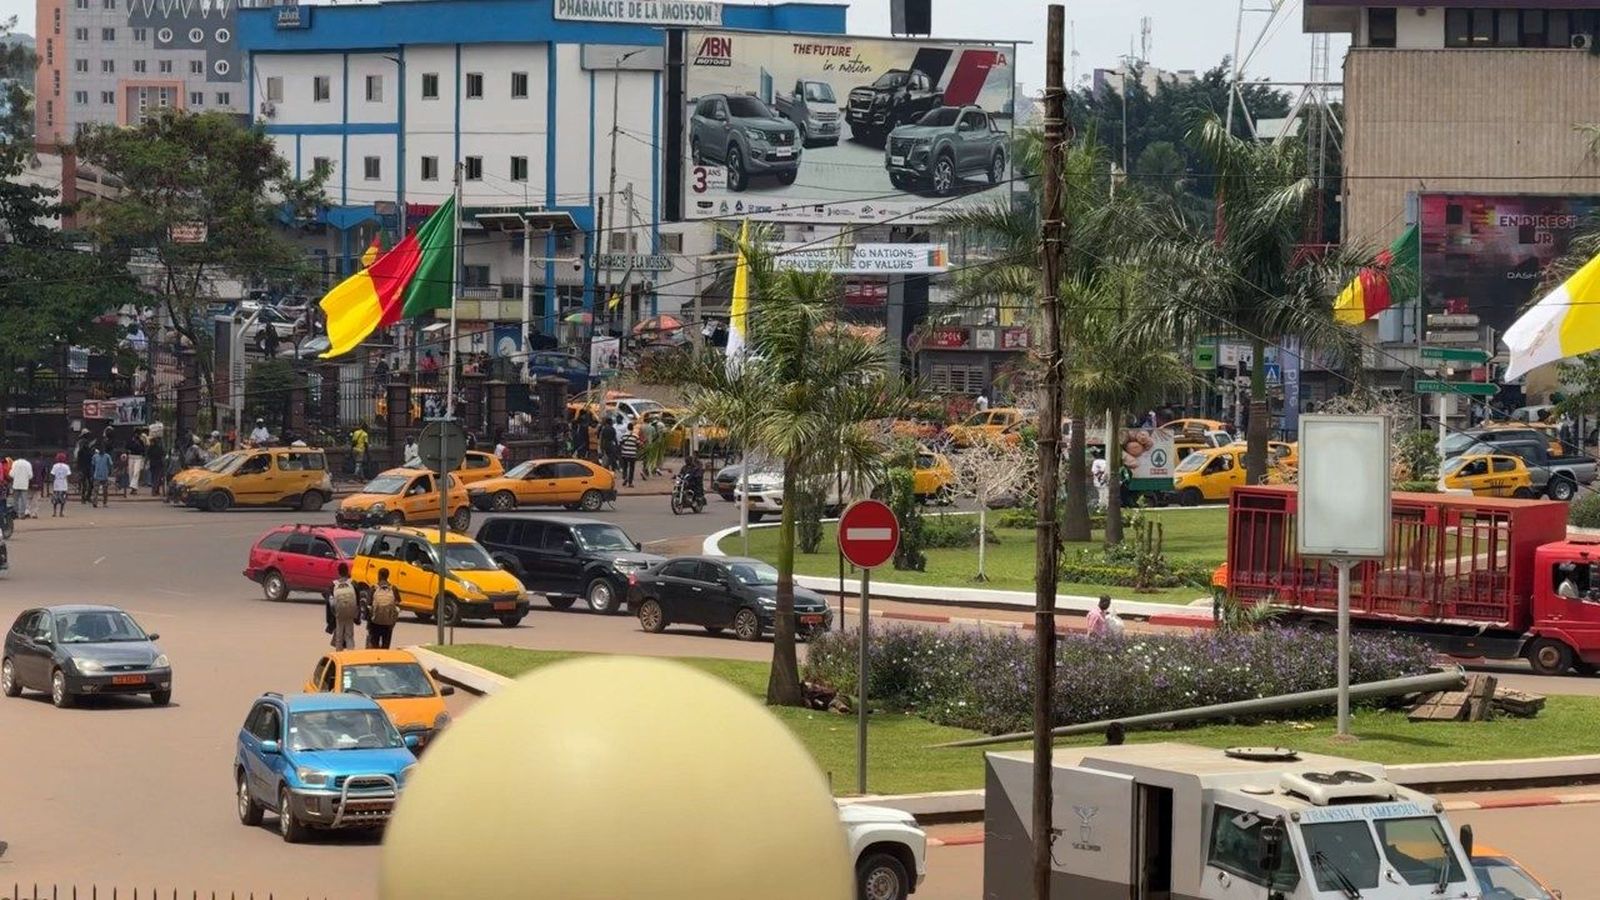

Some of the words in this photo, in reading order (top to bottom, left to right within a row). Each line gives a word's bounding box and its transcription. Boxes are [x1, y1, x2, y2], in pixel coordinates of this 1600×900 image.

[559, 0, 624, 18] PHARMACIE
[628, 1, 642, 19] DE
[645, 2, 656, 19] LA
[662, 2, 712, 21] MOISSON
[698, 36, 732, 58] ABN
[793, 43, 811, 55] THE
[813, 44, 852, 57] FUTURE
[696, 57, 732, 66] MOTORS
[823, 59, 835, 71] in
[839, 54, 872, 73] motion
[692, 167, 708, 193] 3
[1500, 215, 1519, 228] EN
[1522, 214, 1577, 229] DIRECT
[858, 259, 872, 270] OF
[875, 259, 914, 270] VALUES
[1305, 807, 1359, 821] TRANSVAL
[1361, 802, 1422, 819] CAMEROUN
